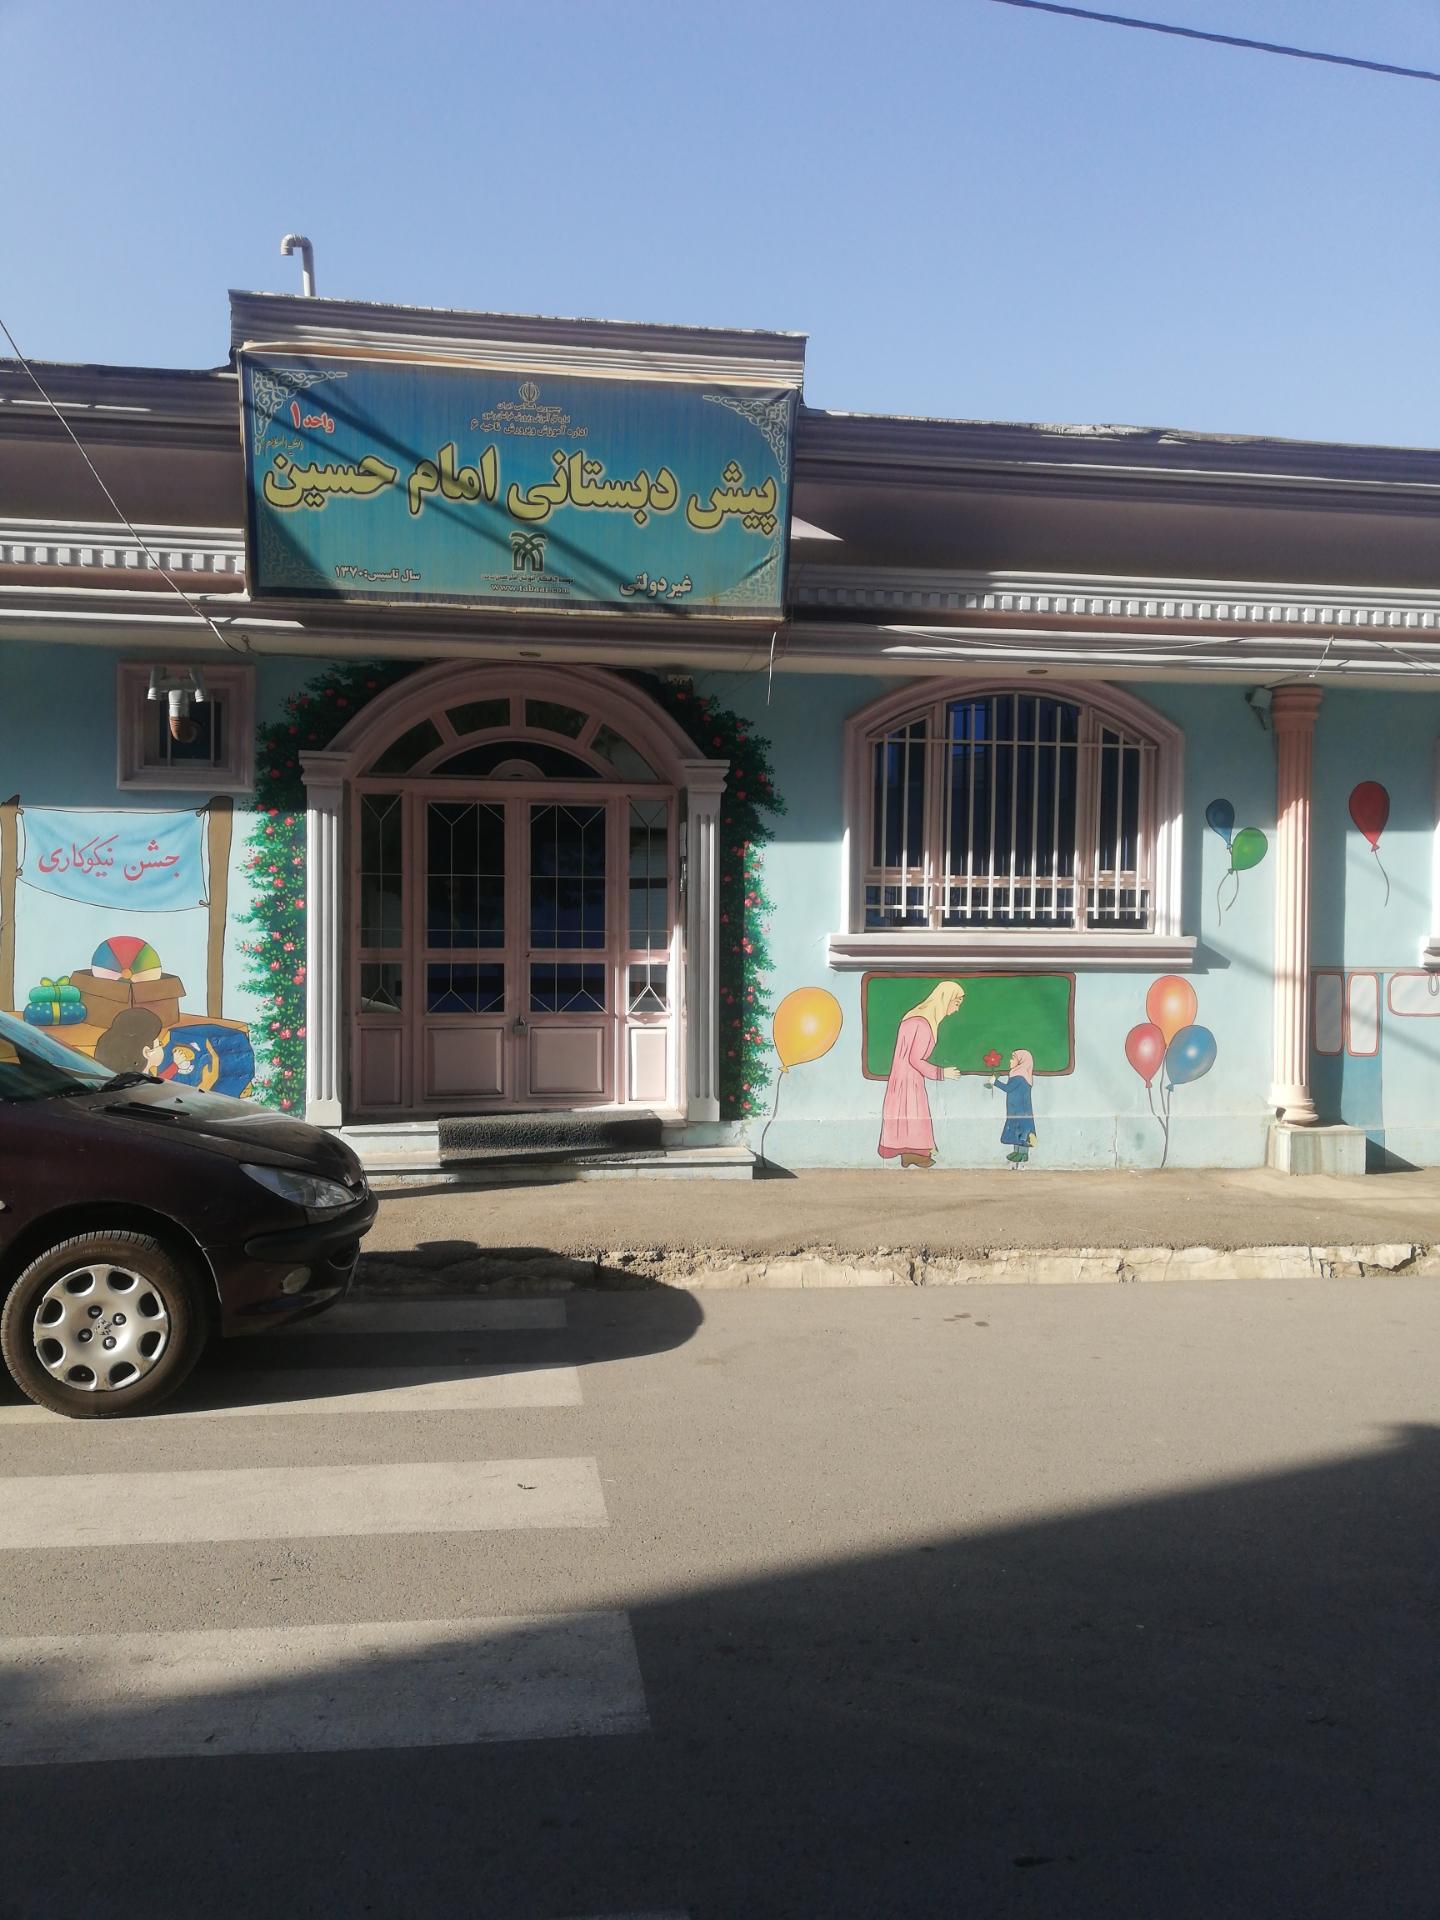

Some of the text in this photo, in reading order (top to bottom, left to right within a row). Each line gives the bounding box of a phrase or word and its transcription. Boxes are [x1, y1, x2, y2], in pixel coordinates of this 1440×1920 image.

[303, 412, 335, 433] واحد
[480, 421, 501, 433] ناحیه
[537, 424, 567, 438] آموزش
[264, 442, 777, 535] پیش دبستانی امام حسین
[401, 567, 421, 582] سال
[38, 834, 180, 881] جشن نیکوکاری
